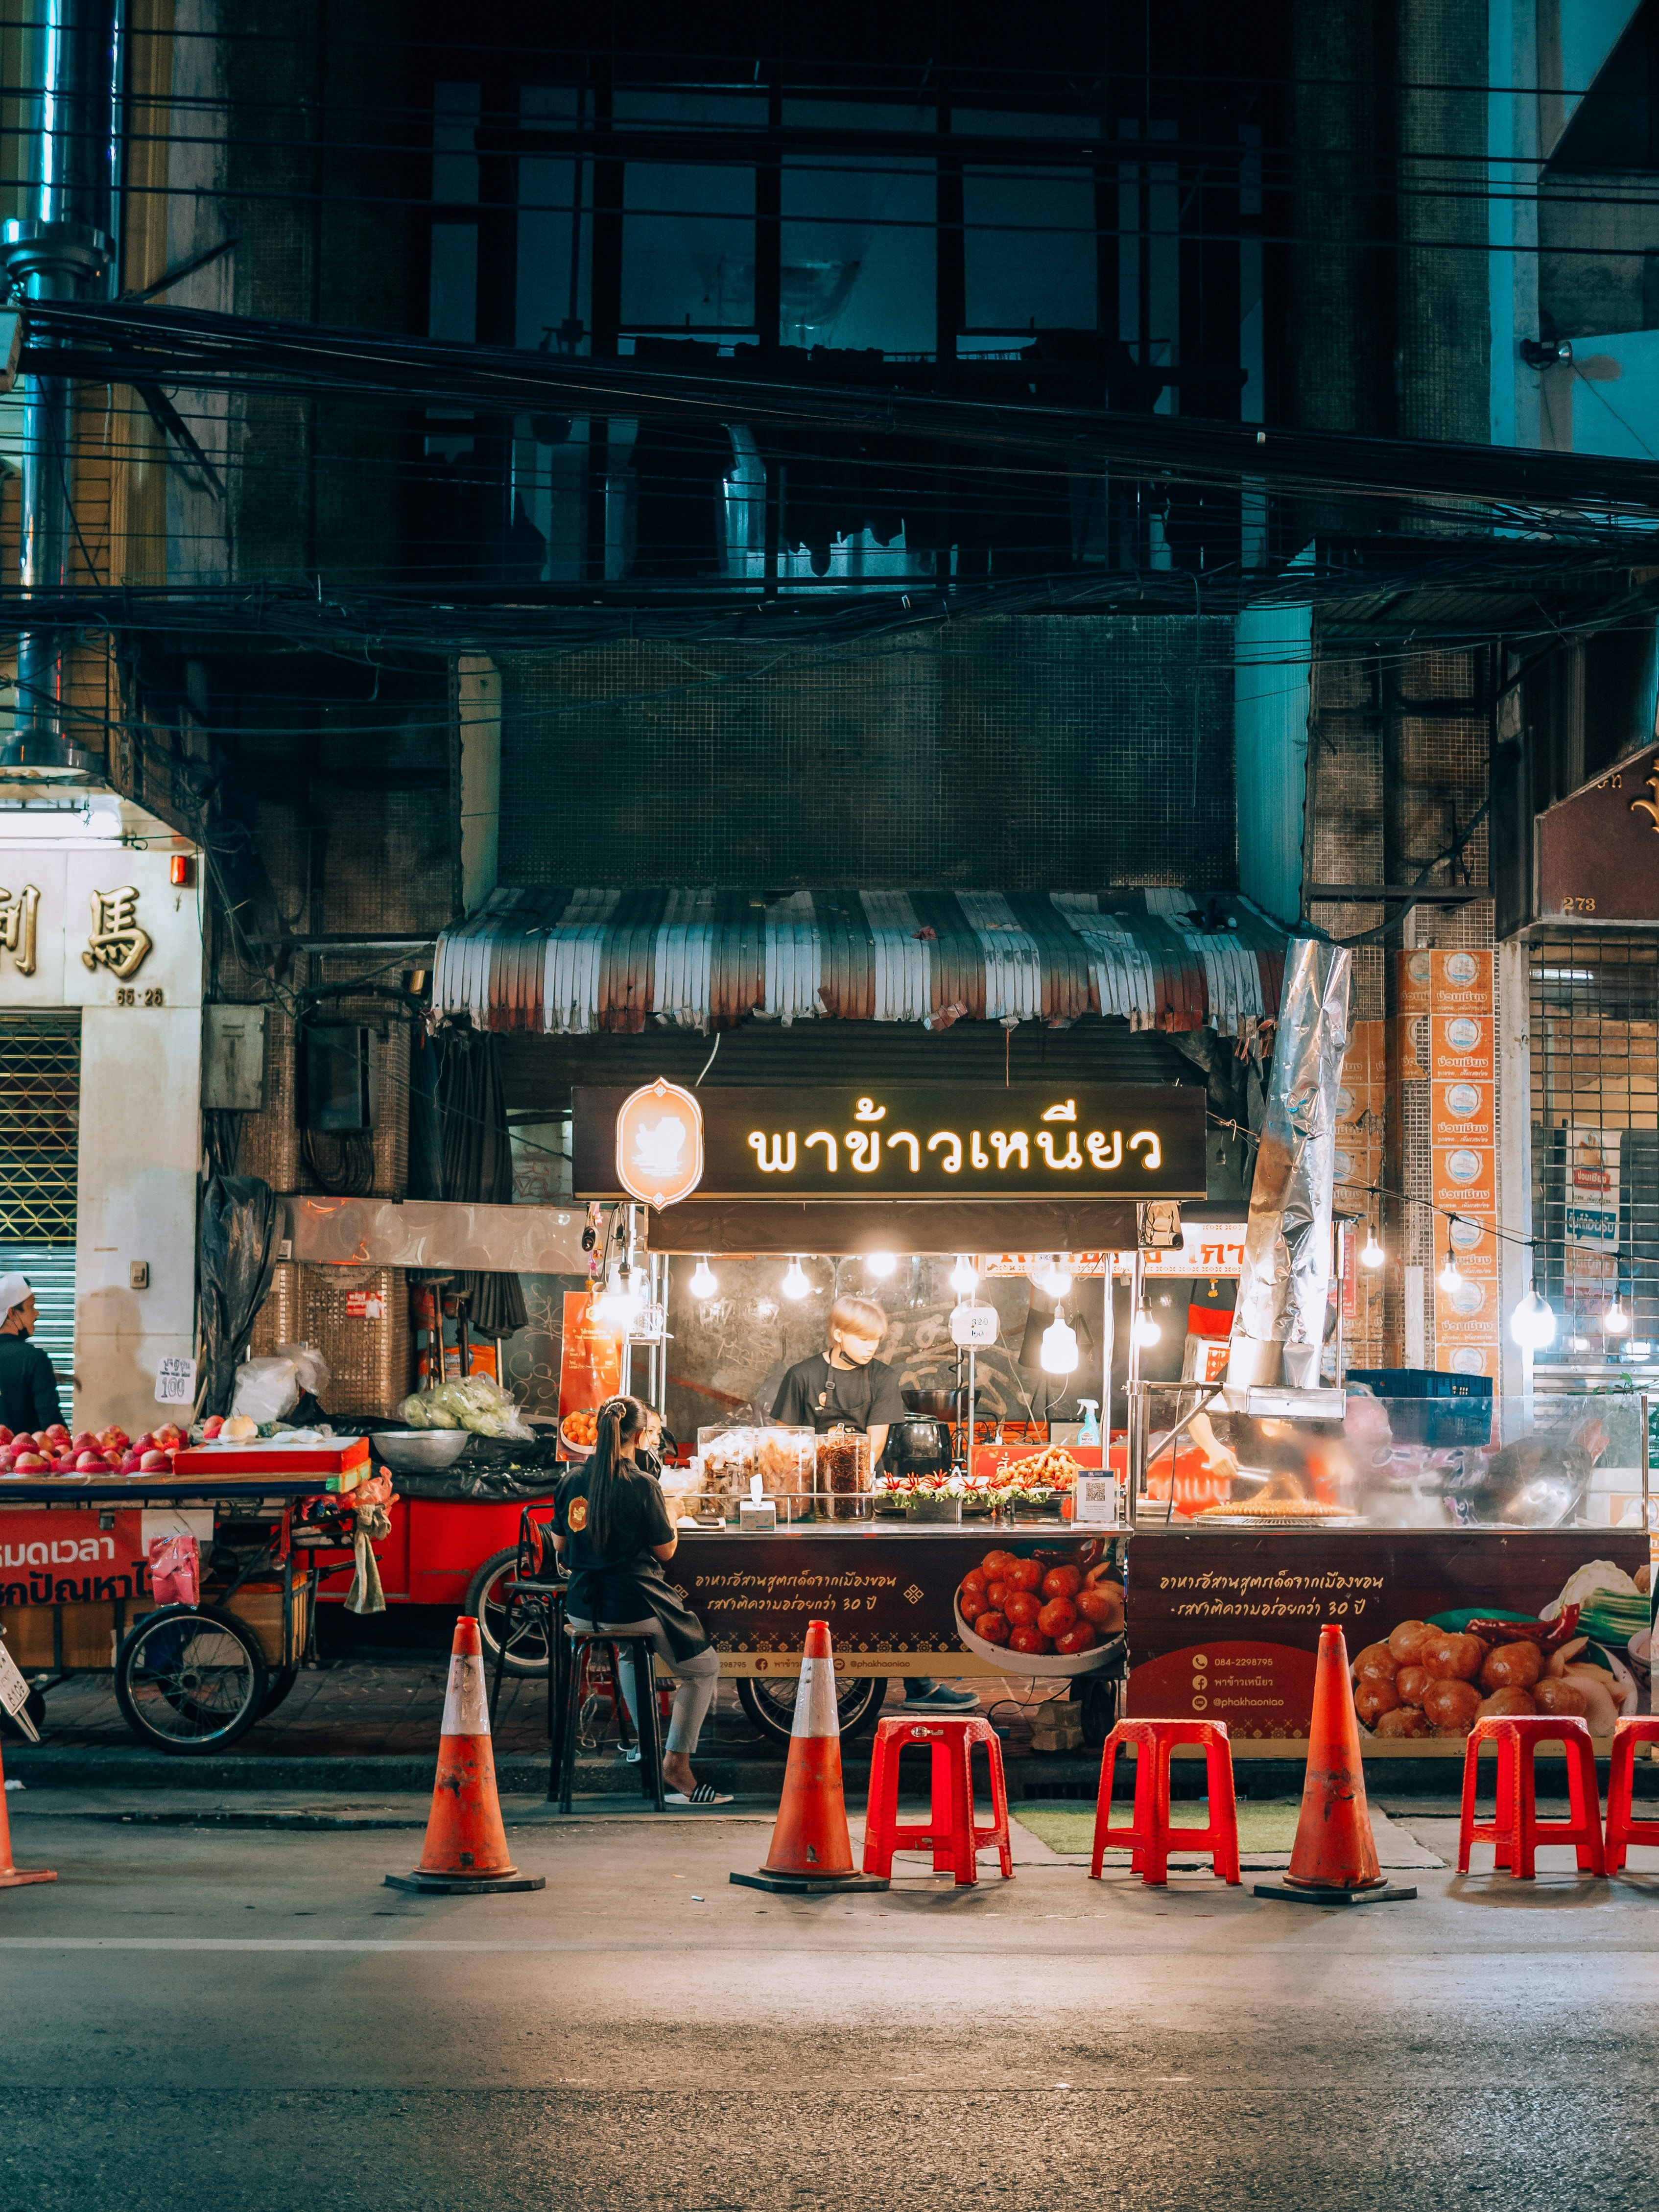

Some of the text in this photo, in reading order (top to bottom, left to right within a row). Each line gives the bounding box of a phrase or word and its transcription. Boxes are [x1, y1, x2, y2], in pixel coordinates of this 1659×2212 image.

[1563, 897, 1596, 911] 273
[748, 1097, 1162, 1173] พาข้าวเหนียว
[0, 1537, 115, 1568] มดเวลา
[0, 1561, 153, 1606] กปัญหาไ
[843, 1598, 861, 1611] 30
[866, 1595, 877, 1610] ปี
[1328, 1602, 1349, 1616] 30
[1354, 1598, 1366, 1616] ปี
[773, 1657, 802, 1668] พาข้าว
[850, 1660, 911, 1669] @phakhaoniao
[1214, 1675, 1273, 1687] พาข้าวเหนียว
[1213, 1697, 1284, 1709] @phakhaoniao
